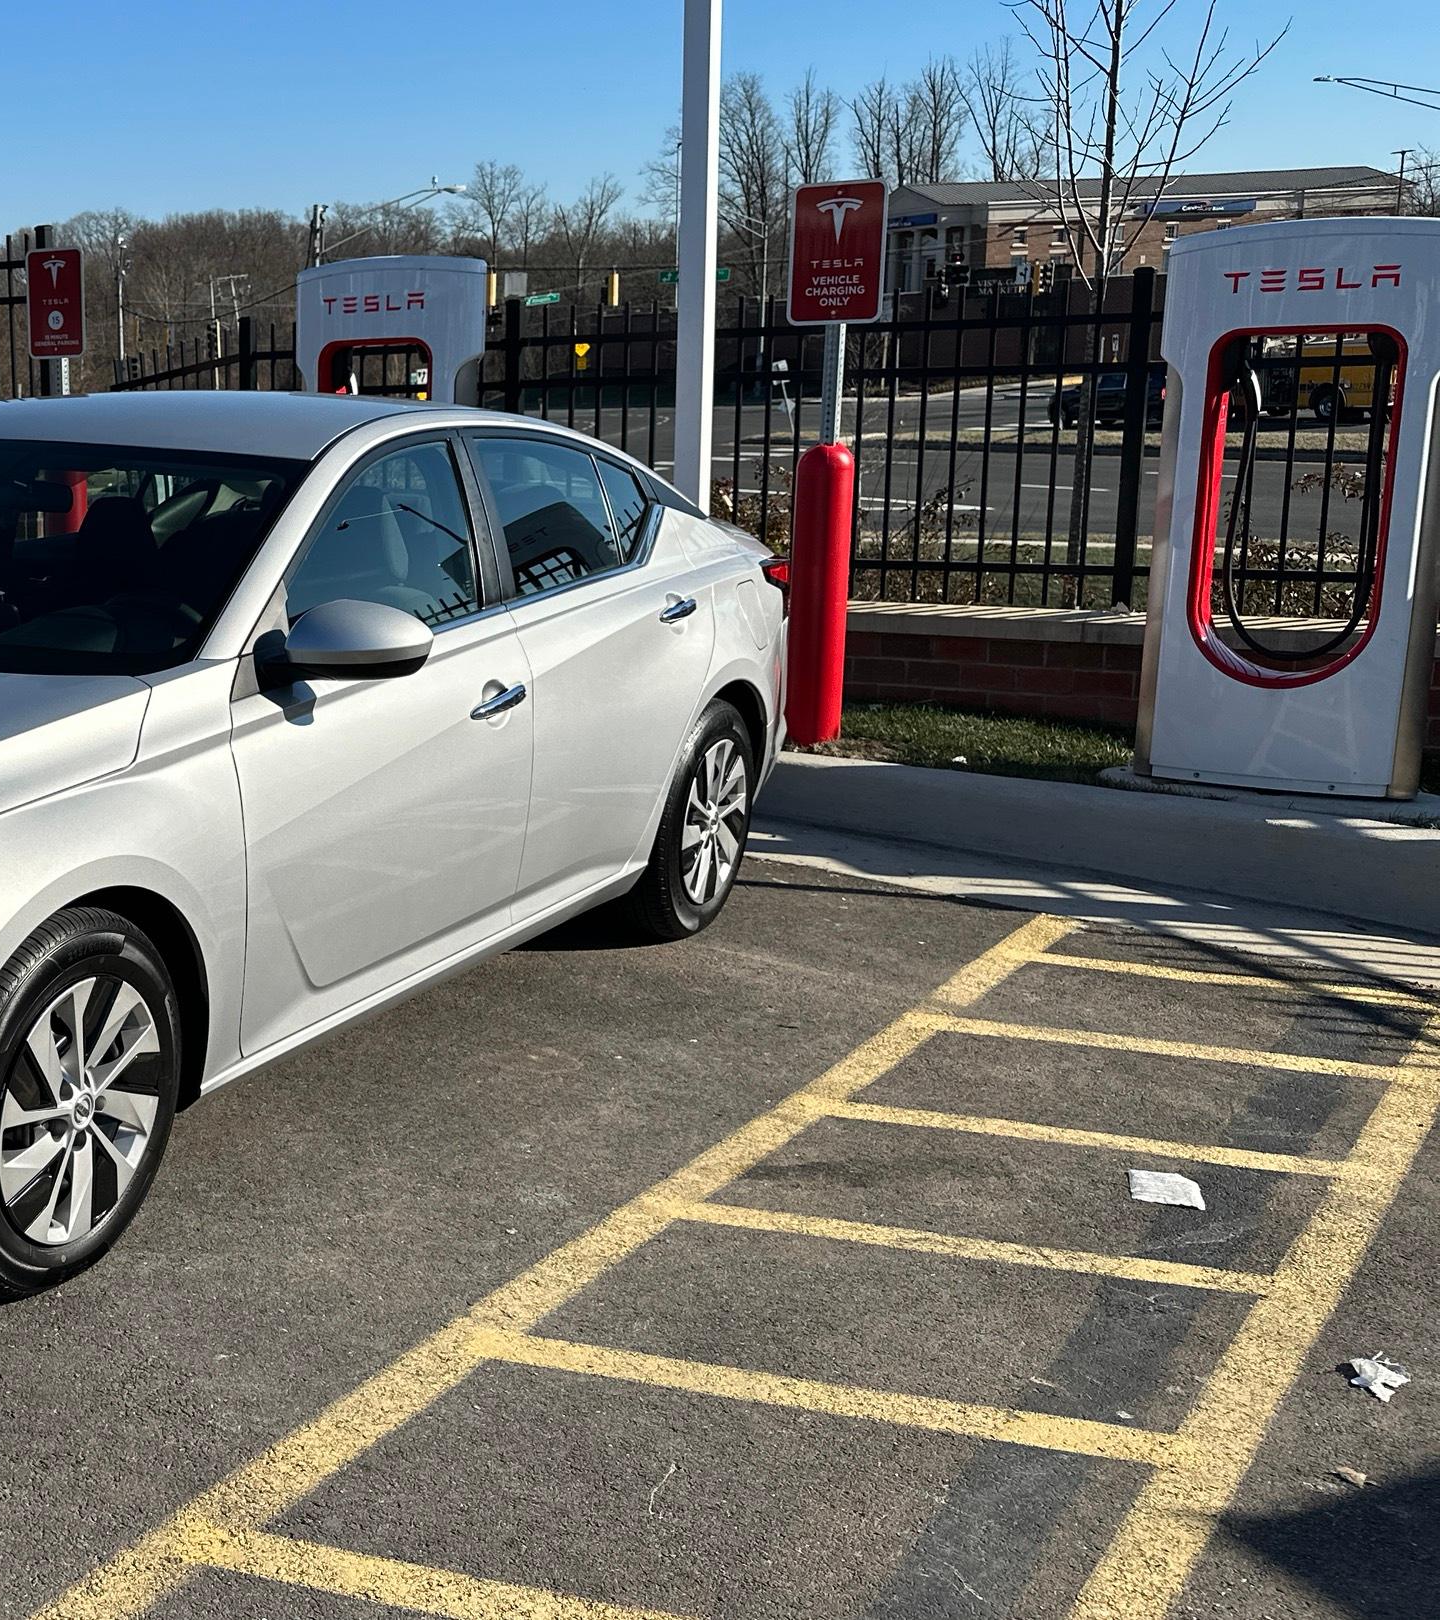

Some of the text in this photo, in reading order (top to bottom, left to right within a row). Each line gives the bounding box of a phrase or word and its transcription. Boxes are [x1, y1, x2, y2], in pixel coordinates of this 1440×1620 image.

[810, 258, 864, 269] TESLA
[811, 275, 860, 286] VEHICLE
[1223, 264, 1402, 294] TESLA
[805, 285, 865, 297] CHARGING
[323, 292, 425, 315] TESLA
[819, 297, 850, 307] ONLY
